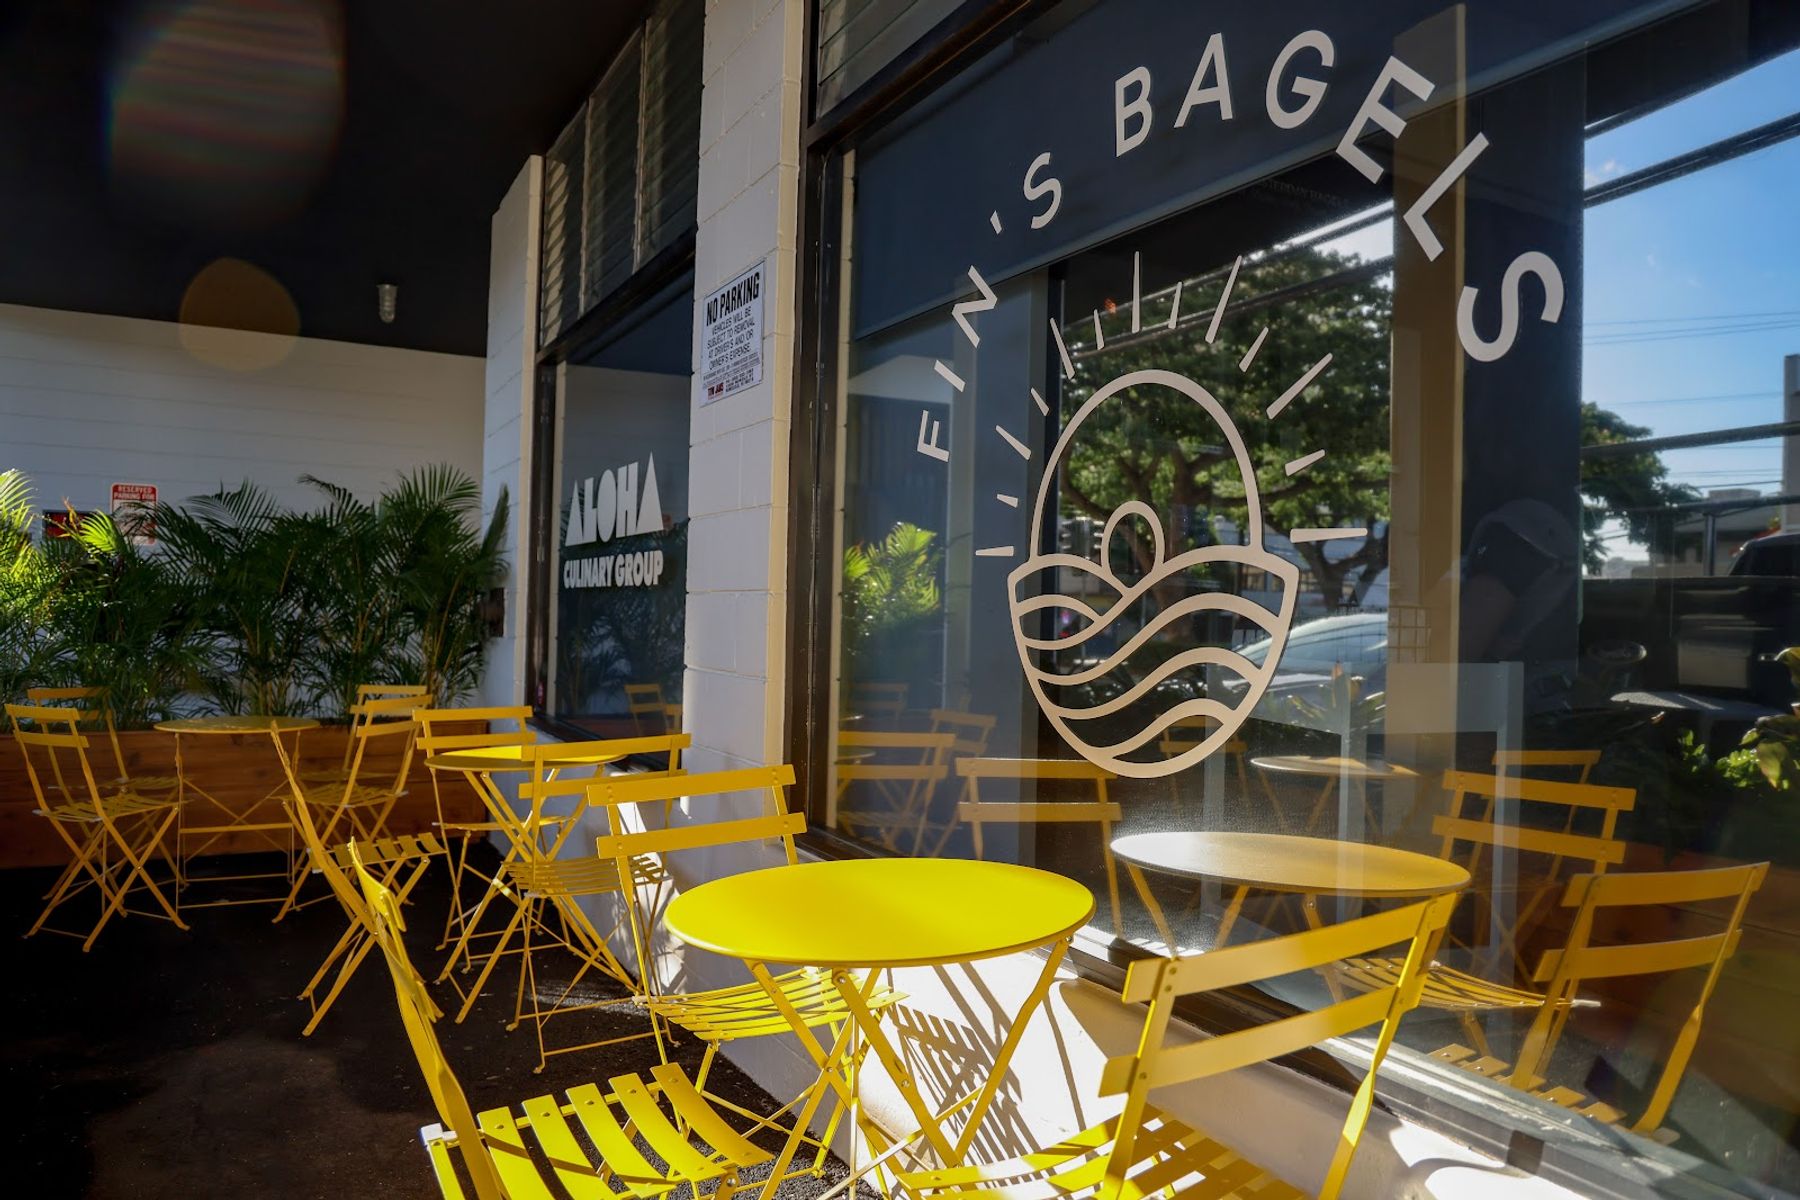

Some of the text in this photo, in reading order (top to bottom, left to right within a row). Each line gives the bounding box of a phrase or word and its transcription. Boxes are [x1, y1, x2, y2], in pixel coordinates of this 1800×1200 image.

[917, 29, 1565, 463] FIN'S BAGELS
[706, 271, 760, 327] NO PARKING
[707, 317, 755, 350] SUBJECT TO REMOVAL
[711, 305, 752, 335] VEHICLES WILL BE
[734, 334, 746, 347] AND
[746, 329, 754, 341] OR
[565, 450, 664, 547] ALOHA
[563, 550, 664, 589] CULINARY GROUP
